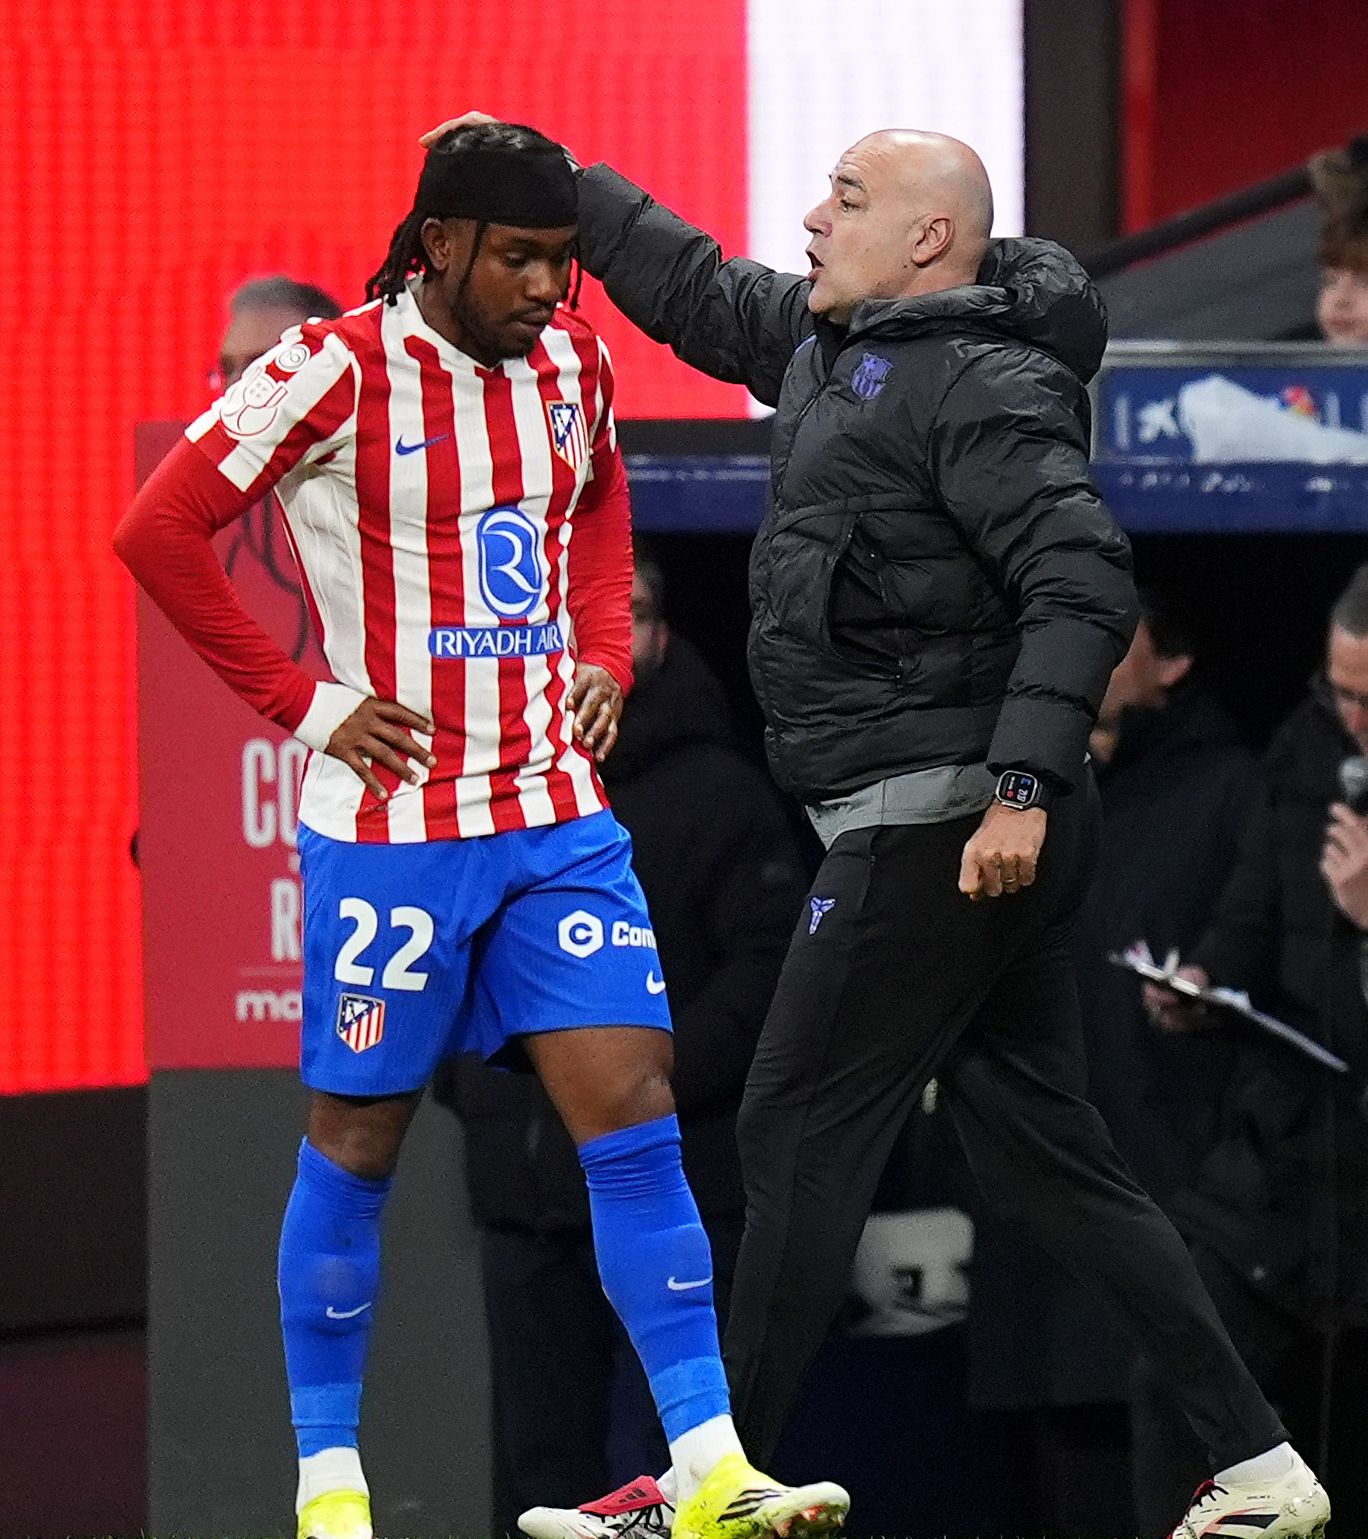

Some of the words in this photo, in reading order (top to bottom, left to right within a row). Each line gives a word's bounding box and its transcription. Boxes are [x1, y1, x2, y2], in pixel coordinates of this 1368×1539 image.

[436, 629, 532, 656] RIYADH
[535, 624, 562, 652] AIR
[334, 897, 434, 991] 22
